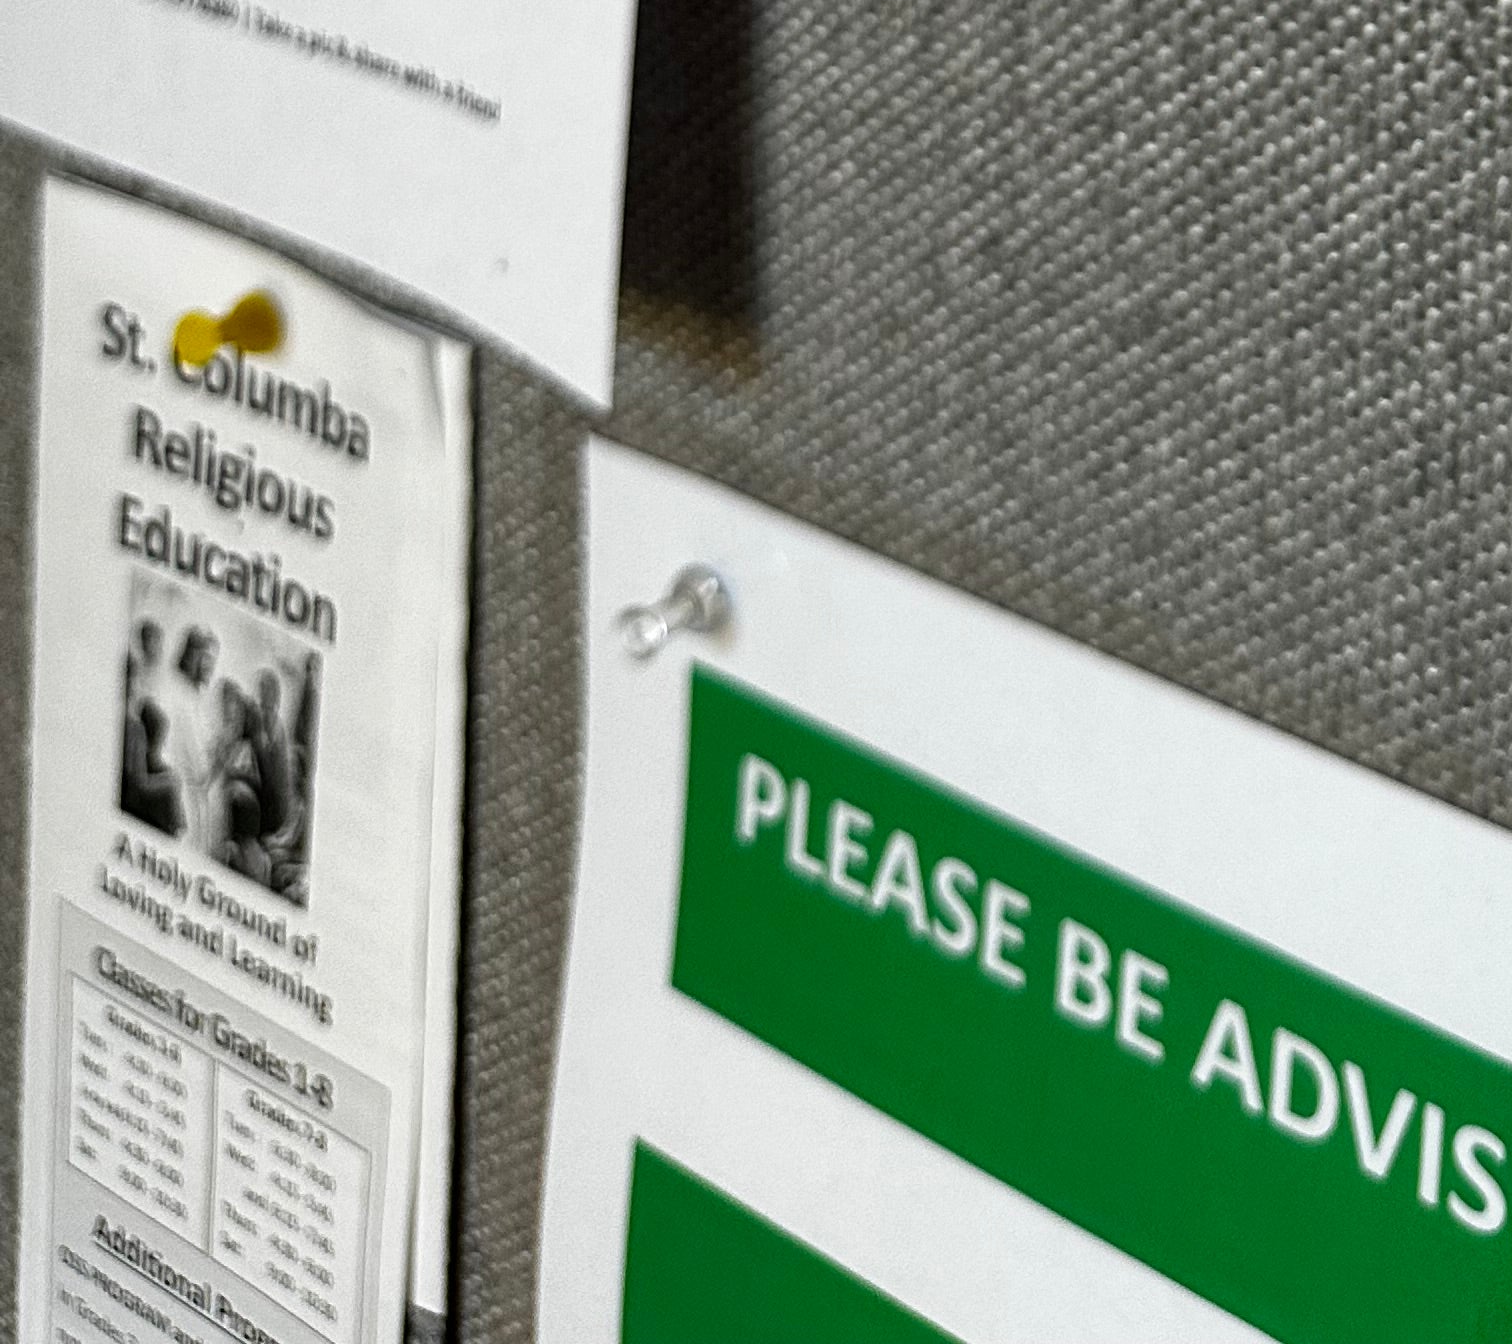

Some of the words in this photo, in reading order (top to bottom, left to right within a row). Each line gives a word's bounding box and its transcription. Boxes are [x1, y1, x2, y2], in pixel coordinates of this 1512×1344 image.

[102, 301, 156, 374] St.
[133, 406, 335, 541] Religious
[118, 492, 337, 643] Education
[138, 841, 192, 903] Holy
[196, 875, 286, 951] Ground
[290, 934, 319, 968] of
[735, 751, 1032, 989] PLEASE
[1054, 918, 1169, 1063] BE
[177, 914, 224, 959] and
[225, 934, 333, 1027] Learning
[210, 1013, 291, 1085] Grades
